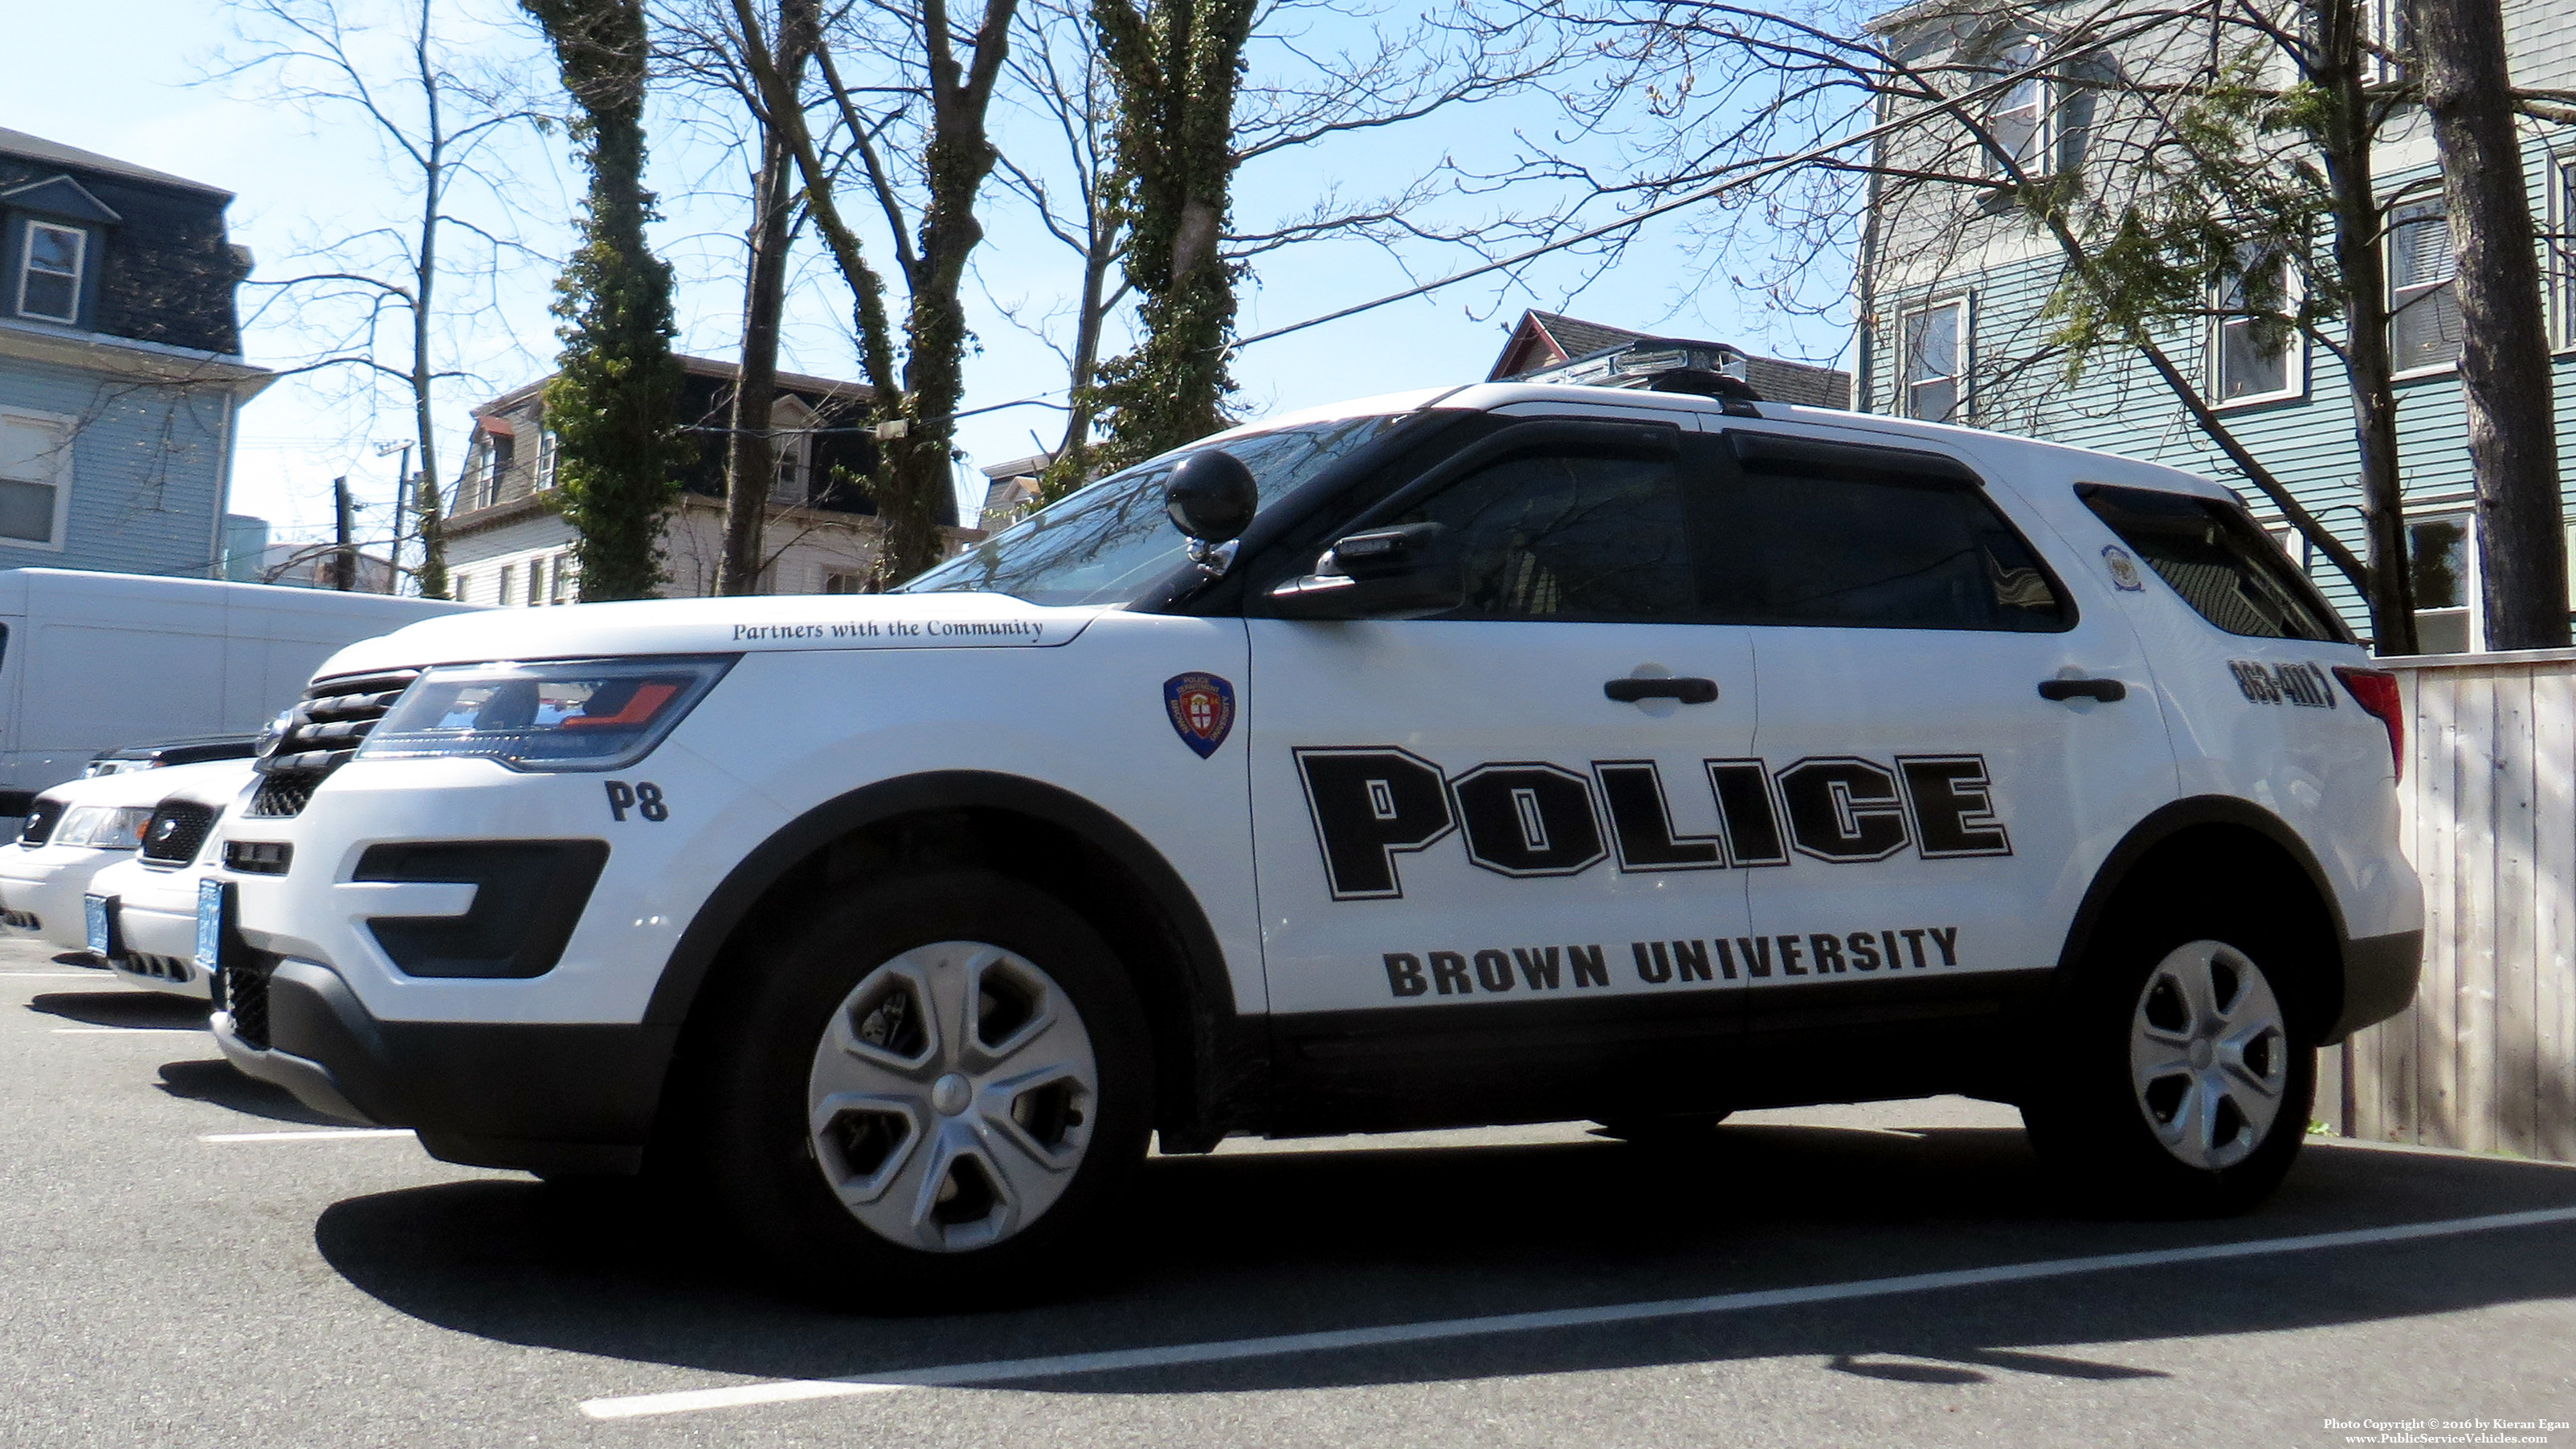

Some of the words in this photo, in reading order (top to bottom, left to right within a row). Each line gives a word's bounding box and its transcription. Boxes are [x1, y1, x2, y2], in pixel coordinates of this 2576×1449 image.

[733, 623, 823, 641] Partners
[831, 621, 880, 637] with
[888, 620, 921, 636] the
[927, 618, 1044, 643] Community
[604, 780, 669, 822] P8
[1292, 745, 2013, 901] POLICE
[1382, 945, 1610, 997] BROWN
[1631, 926, 1958, 984] UNIVERSITY
